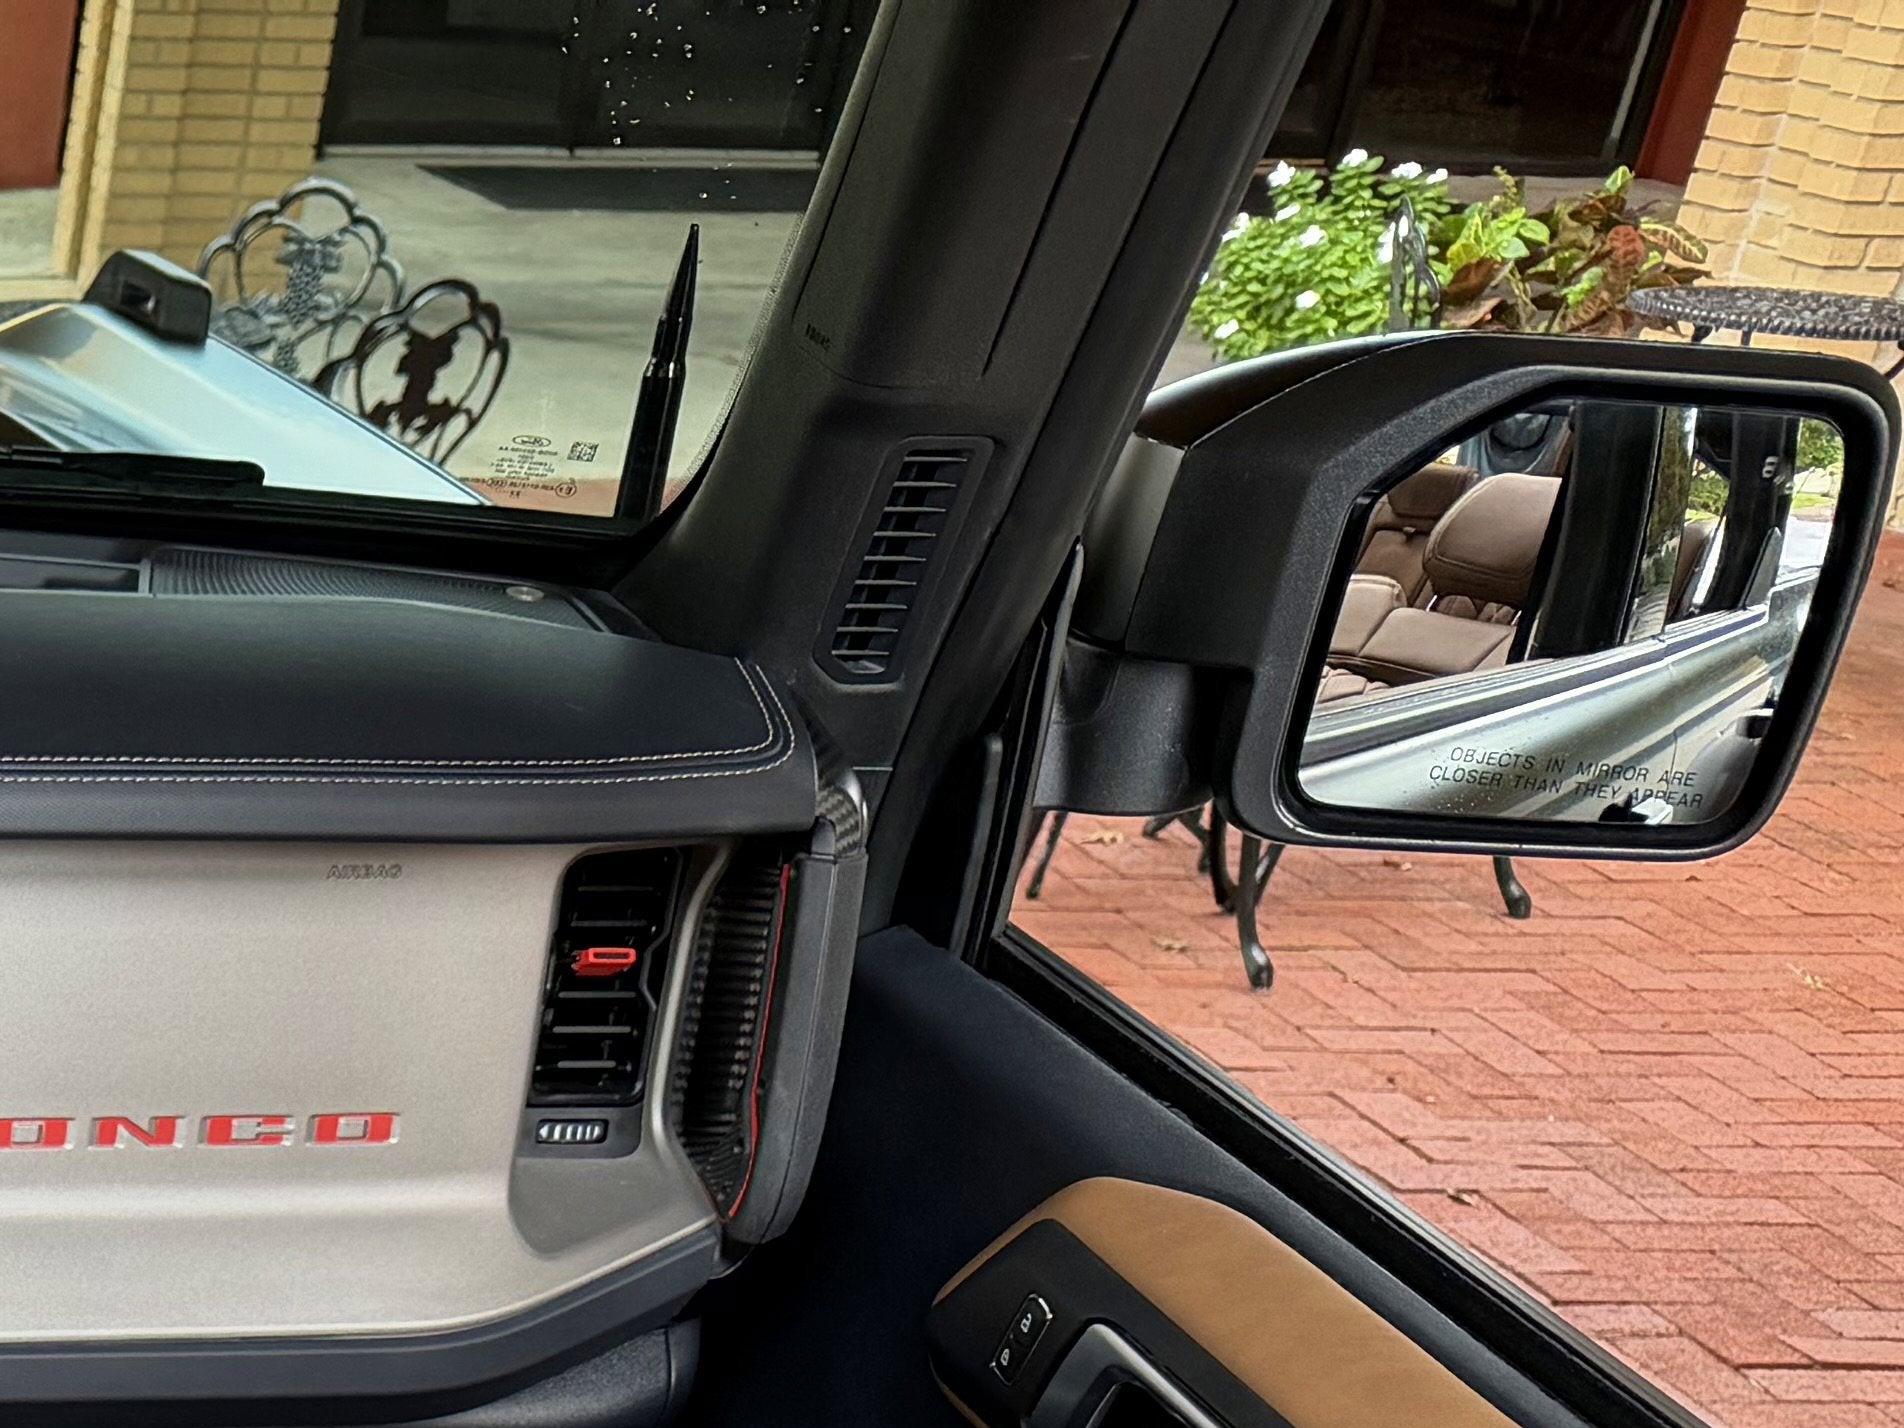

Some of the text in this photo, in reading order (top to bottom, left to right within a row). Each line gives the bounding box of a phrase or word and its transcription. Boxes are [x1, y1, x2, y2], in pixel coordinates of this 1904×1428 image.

[1429, 765, 1704, 808] CLOSER THAN THEY APPEAR
[1450, 747, 1698, 788] OBJECTS IN MIRROR ARE
[326, 863, 403, 880] AIRBAG
